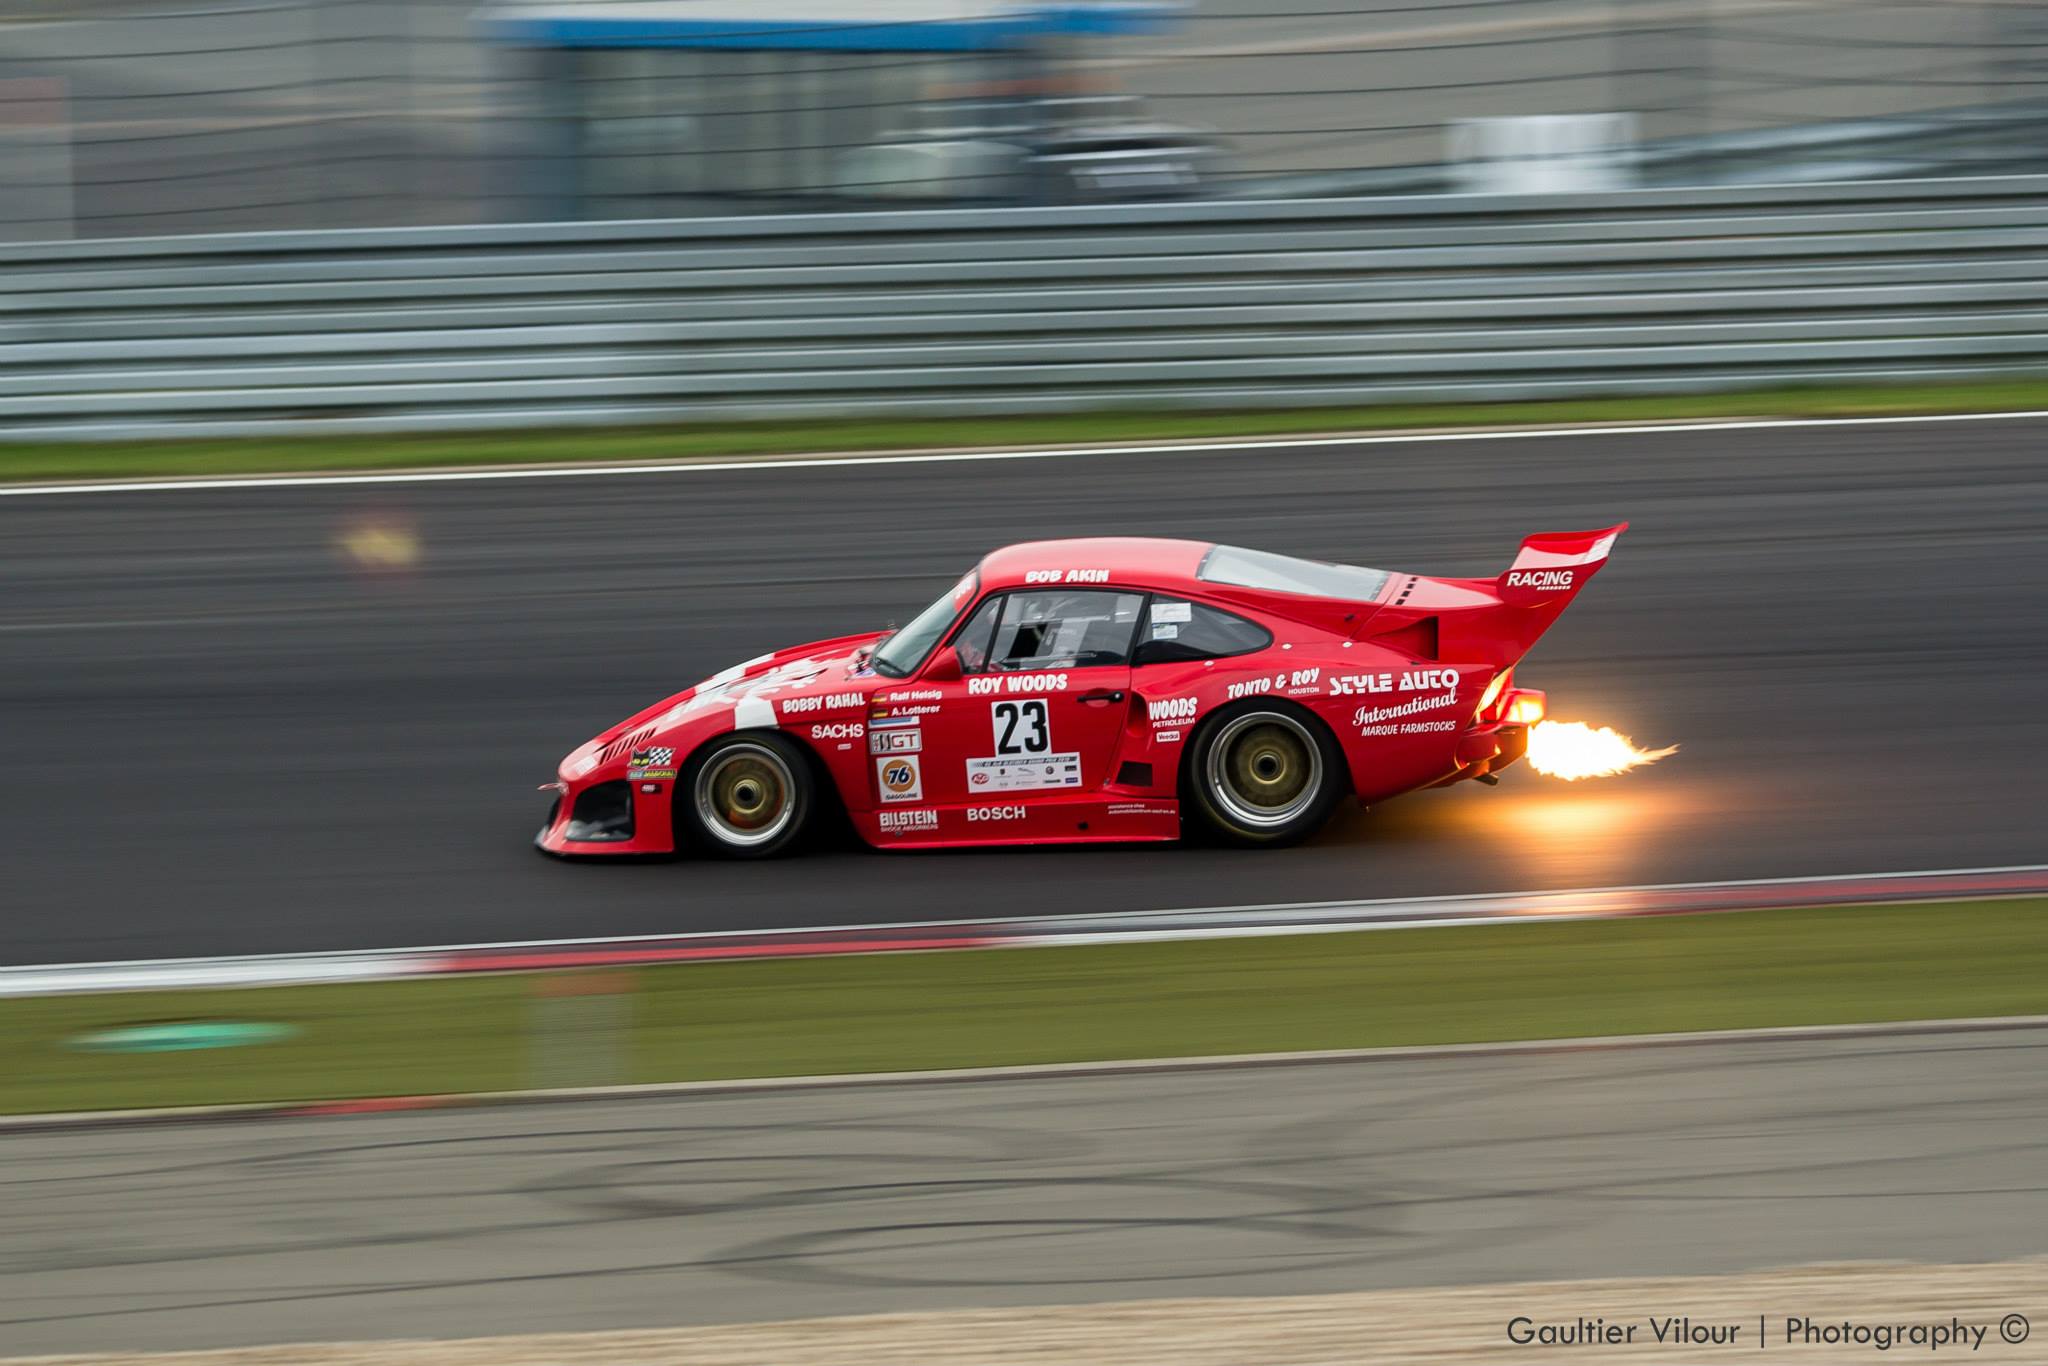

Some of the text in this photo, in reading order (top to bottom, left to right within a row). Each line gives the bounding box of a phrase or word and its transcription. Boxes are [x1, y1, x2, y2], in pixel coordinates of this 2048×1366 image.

[1025, 569, 1109, 583] BOB AKIN
[1507, 571, 1573, 586] RACING
[968, 674, 1068, 695] ROY WOODS
[1228, 667, 1320, 699] TONTO & ROY
[1288, 687, 1320, 695] HOUSTON
[1329, 669, 1460, 696] STYLE AUTO
[782, 692, 866, 713] BOBBY RAHAL
[1149, 697, 1198, 720] WOODS
[1352, 686, 1458, 726] International
[811, 723, 864, 738] SACHS
[995, 701, 1048, 754] 23
[1152, 717, 1196, 728] PETROLEUM
[1361, 720, 1456, 736] MARQUE FARMSTOCKS
[887, 765, 911, 785] 76
[879, 810, 938, 826] BILSTEIN
[967, 806, 1026, 821] BOSCH
